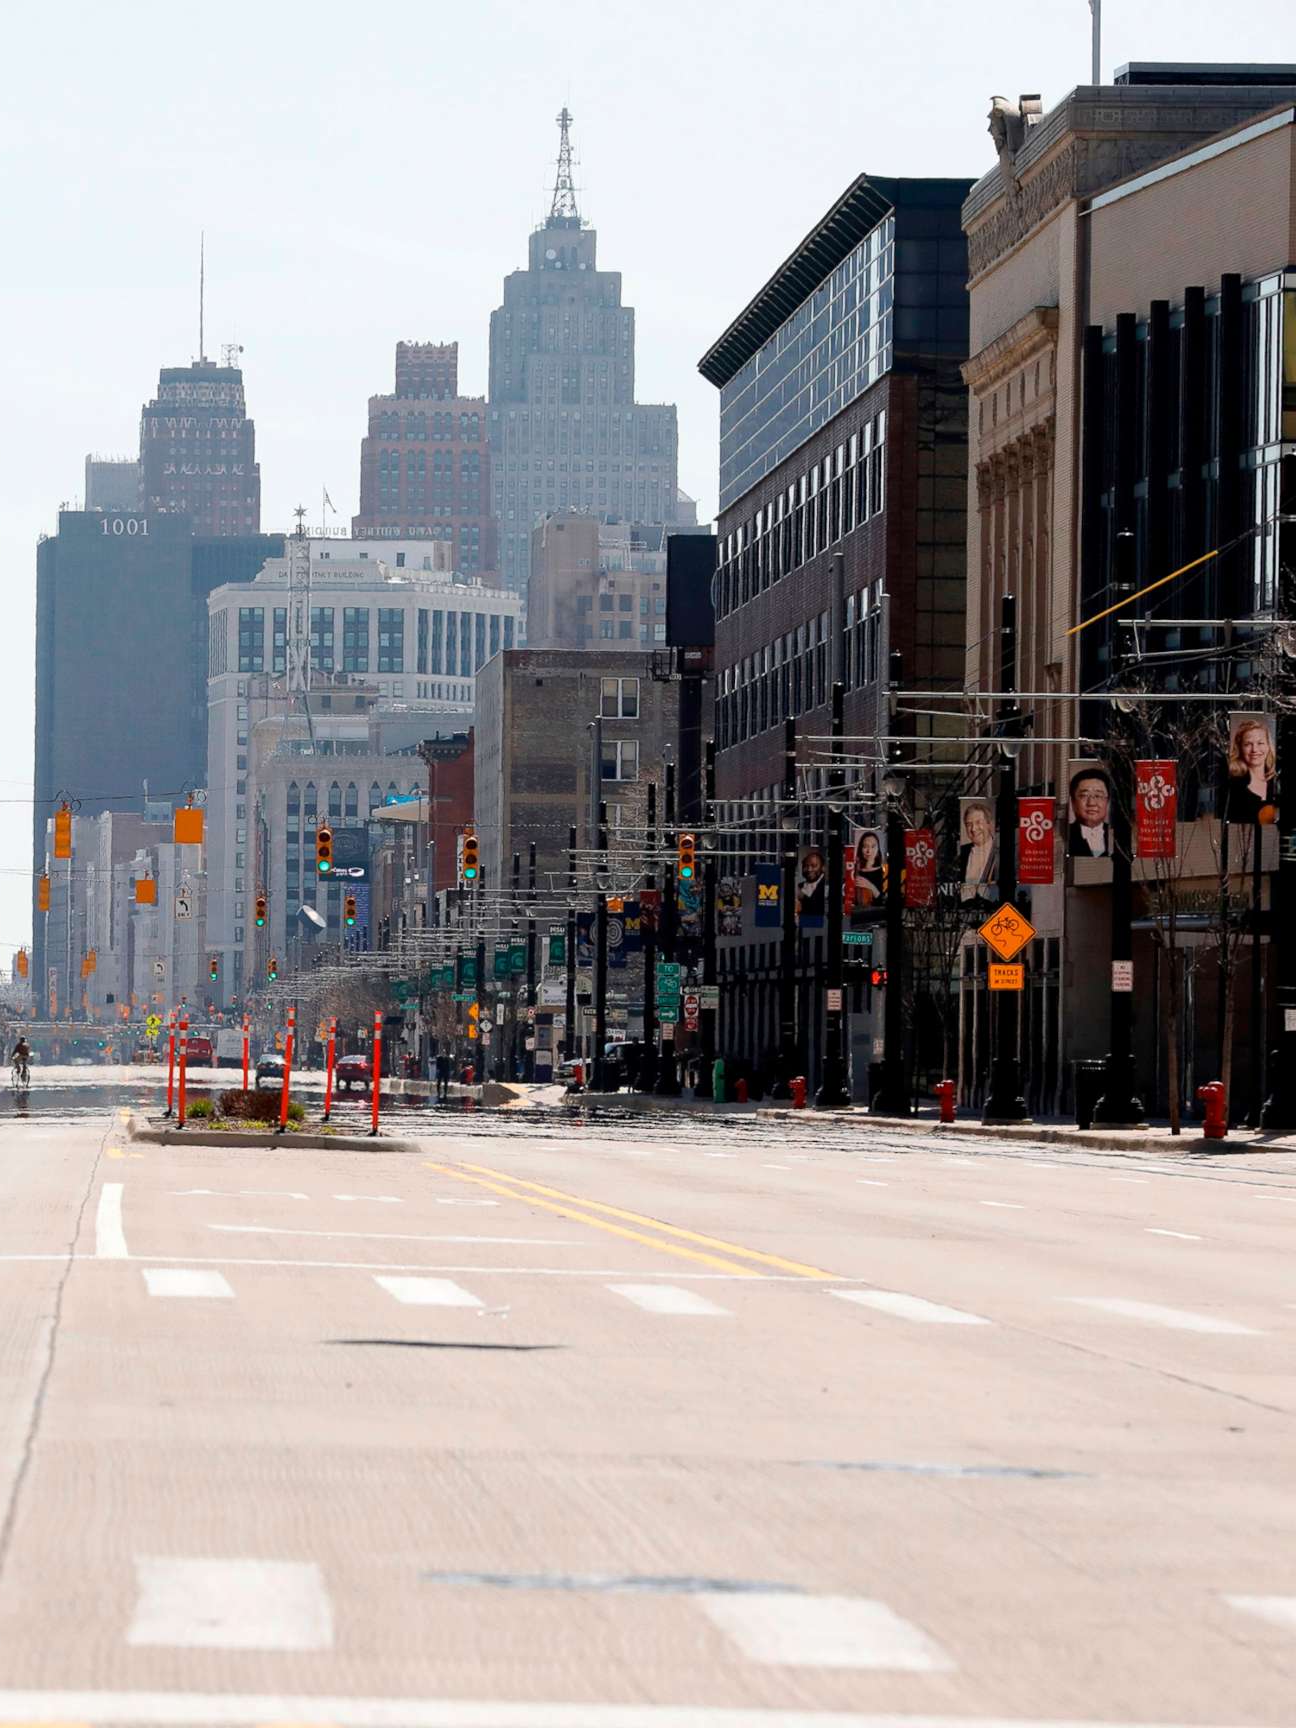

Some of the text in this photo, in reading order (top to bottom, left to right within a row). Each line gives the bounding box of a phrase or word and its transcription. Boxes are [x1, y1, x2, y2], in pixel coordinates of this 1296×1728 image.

[99, 518, 150, 537] 1001
[758, 884, 779, 900] M
[994, 968, 1019, 976] TRACKS
